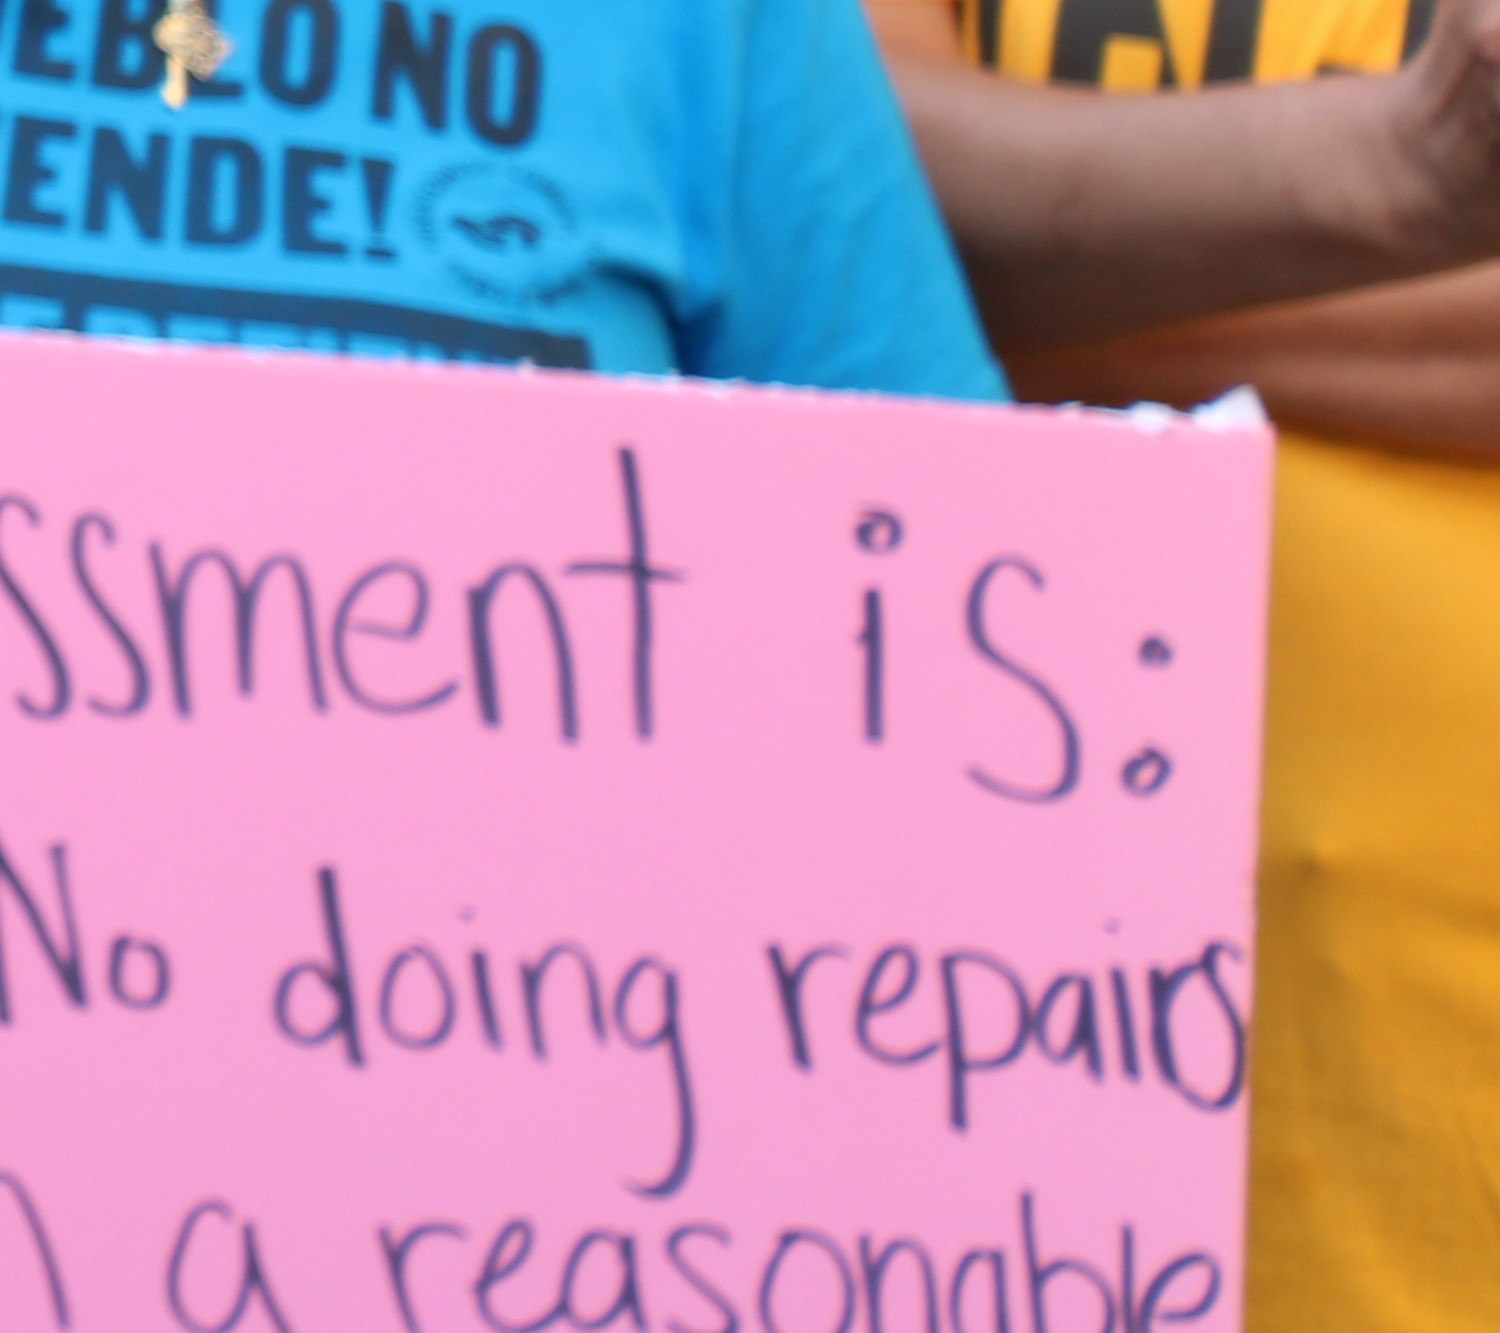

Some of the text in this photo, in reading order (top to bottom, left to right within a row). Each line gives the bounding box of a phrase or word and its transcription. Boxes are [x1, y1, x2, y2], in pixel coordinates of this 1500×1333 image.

[855, 511, 1178, 805] is:
[272, 866, 696, 1198] doing
[767, 919, 1247, 1134] repairs
[167, 1199, 296, 1333] a
[377, 1189, 1221, 1333] reasonable
